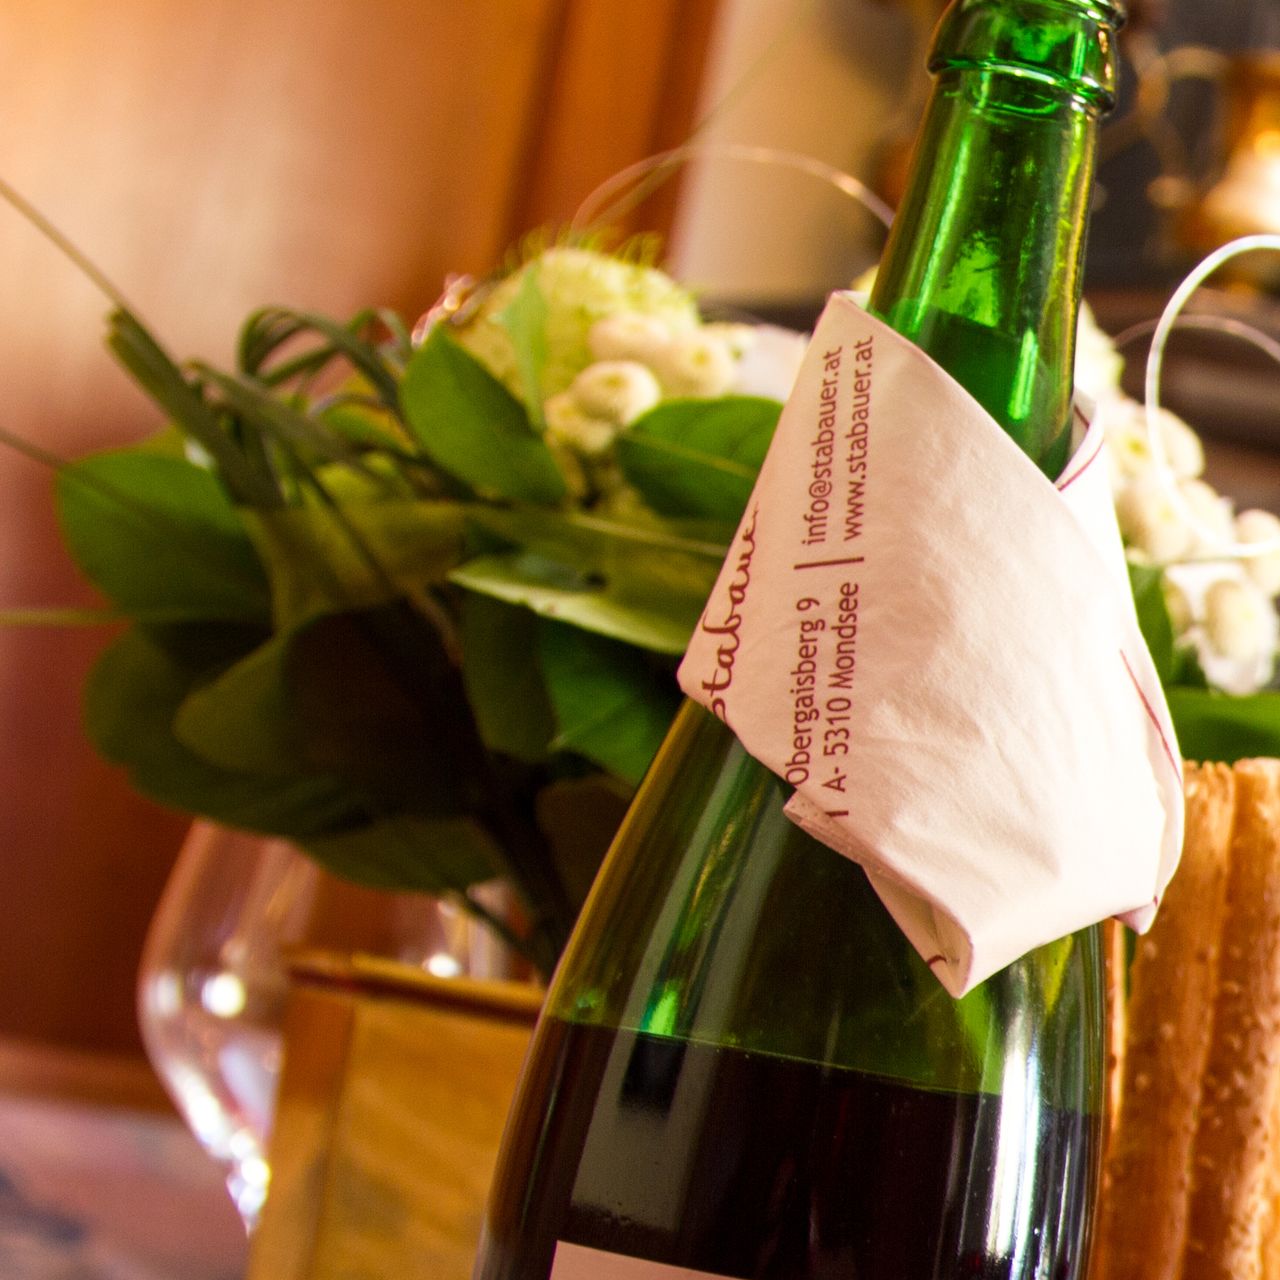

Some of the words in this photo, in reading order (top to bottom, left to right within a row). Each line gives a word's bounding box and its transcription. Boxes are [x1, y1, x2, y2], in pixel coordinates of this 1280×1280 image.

[801, 346, 843, 546] info@stabauer.at
[843, 335, 874, 542] www.stabauer.at
[795, 597, 821, 612] 9
[828, 582, 859, 690] Mondsee
[784, 618, 826, 787] Obergaisberg
[823, 697, 852, 757] 5310
